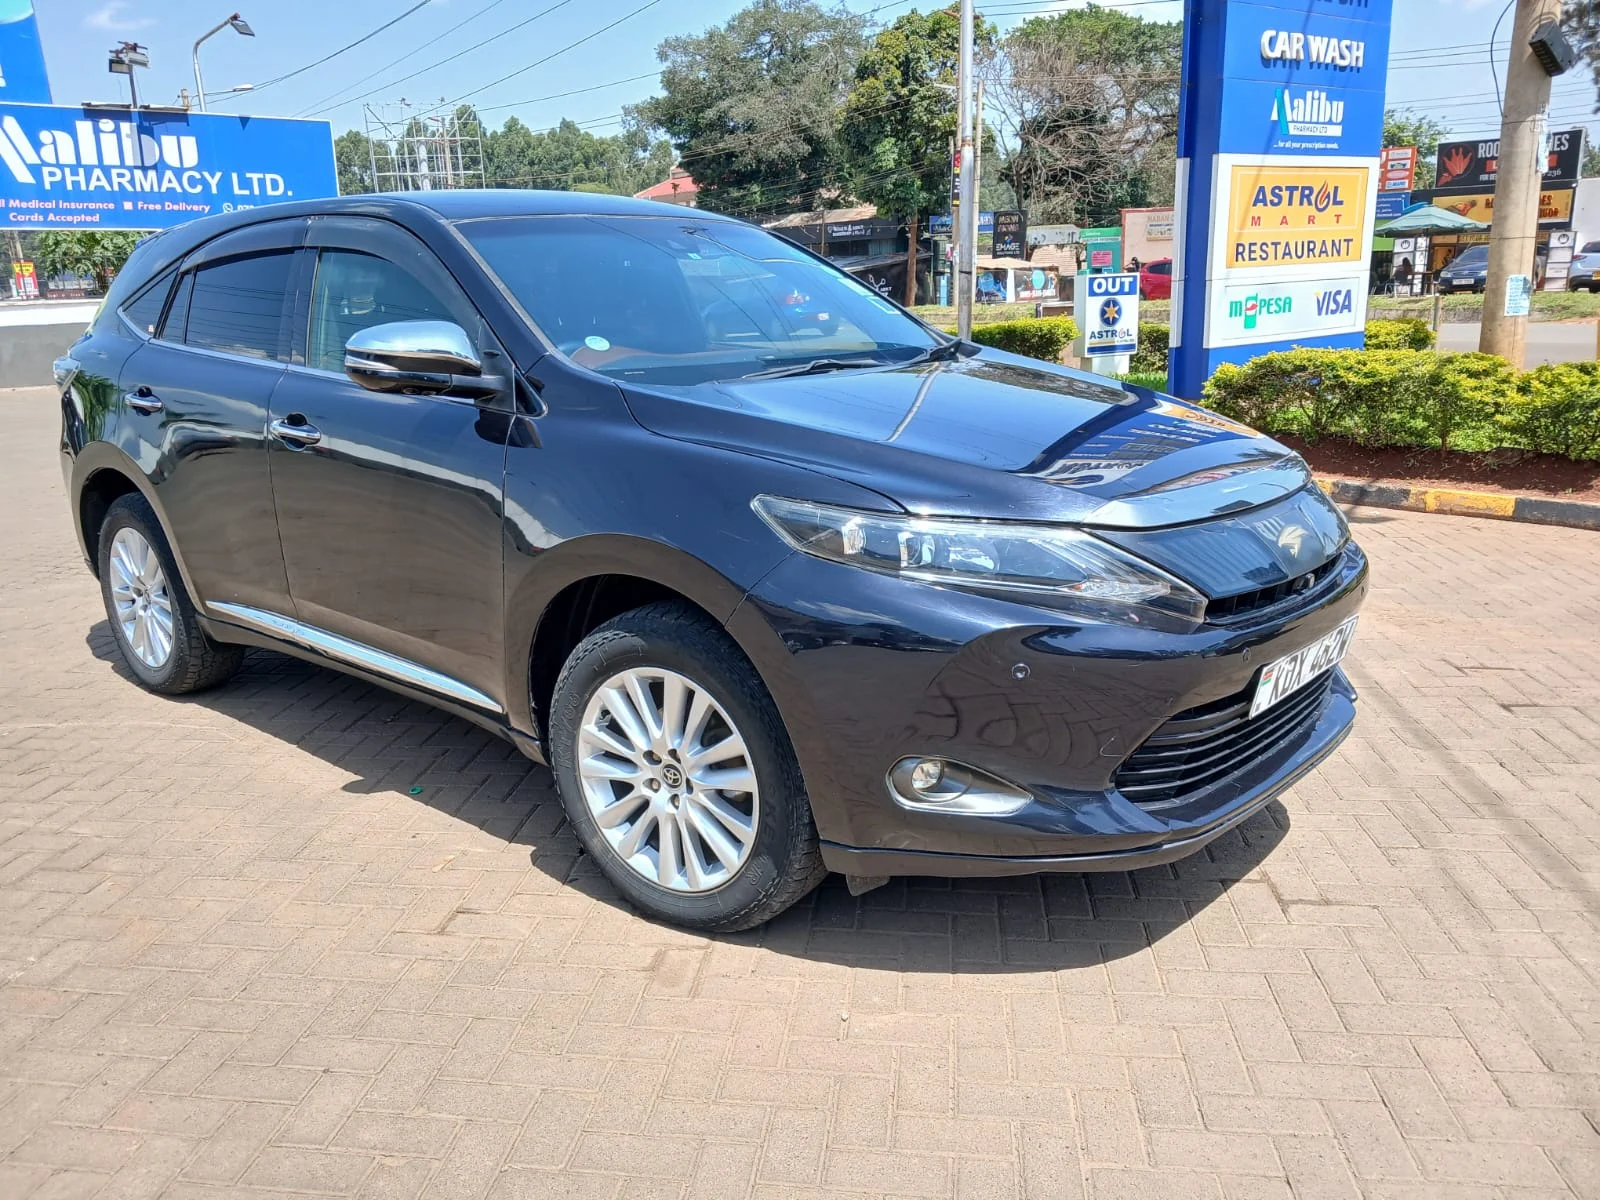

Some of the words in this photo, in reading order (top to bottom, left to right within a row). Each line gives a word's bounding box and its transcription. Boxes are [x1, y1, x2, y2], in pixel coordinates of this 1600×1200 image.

[1261, 30, 1304, 61] CAR
[1307, 34, 1365, 68] WASH
[1270, 88, 1344, 135] Malibu
[42, 166, 224, 195] PHARMACY
[232, 172, 293, 197] LTD.
[9, 199, 56, 209] Medical
[58, 200, 115, 211] Insurance
[137, 202, 163, 212] Free
[165, 202, 211, 214] Delivery
[1252, 180, 1344, 213] ASTROL
[9, 212, 45, 222] Cards
[47, 213, 100, 224] Accepted
[1250, 214, 1342, 227] MART
[1235, 238, 1354, 263] RESTAURANT
[1092, 277, 1134, 294] OUT
[1316, 289, 1352, 317] VISA
